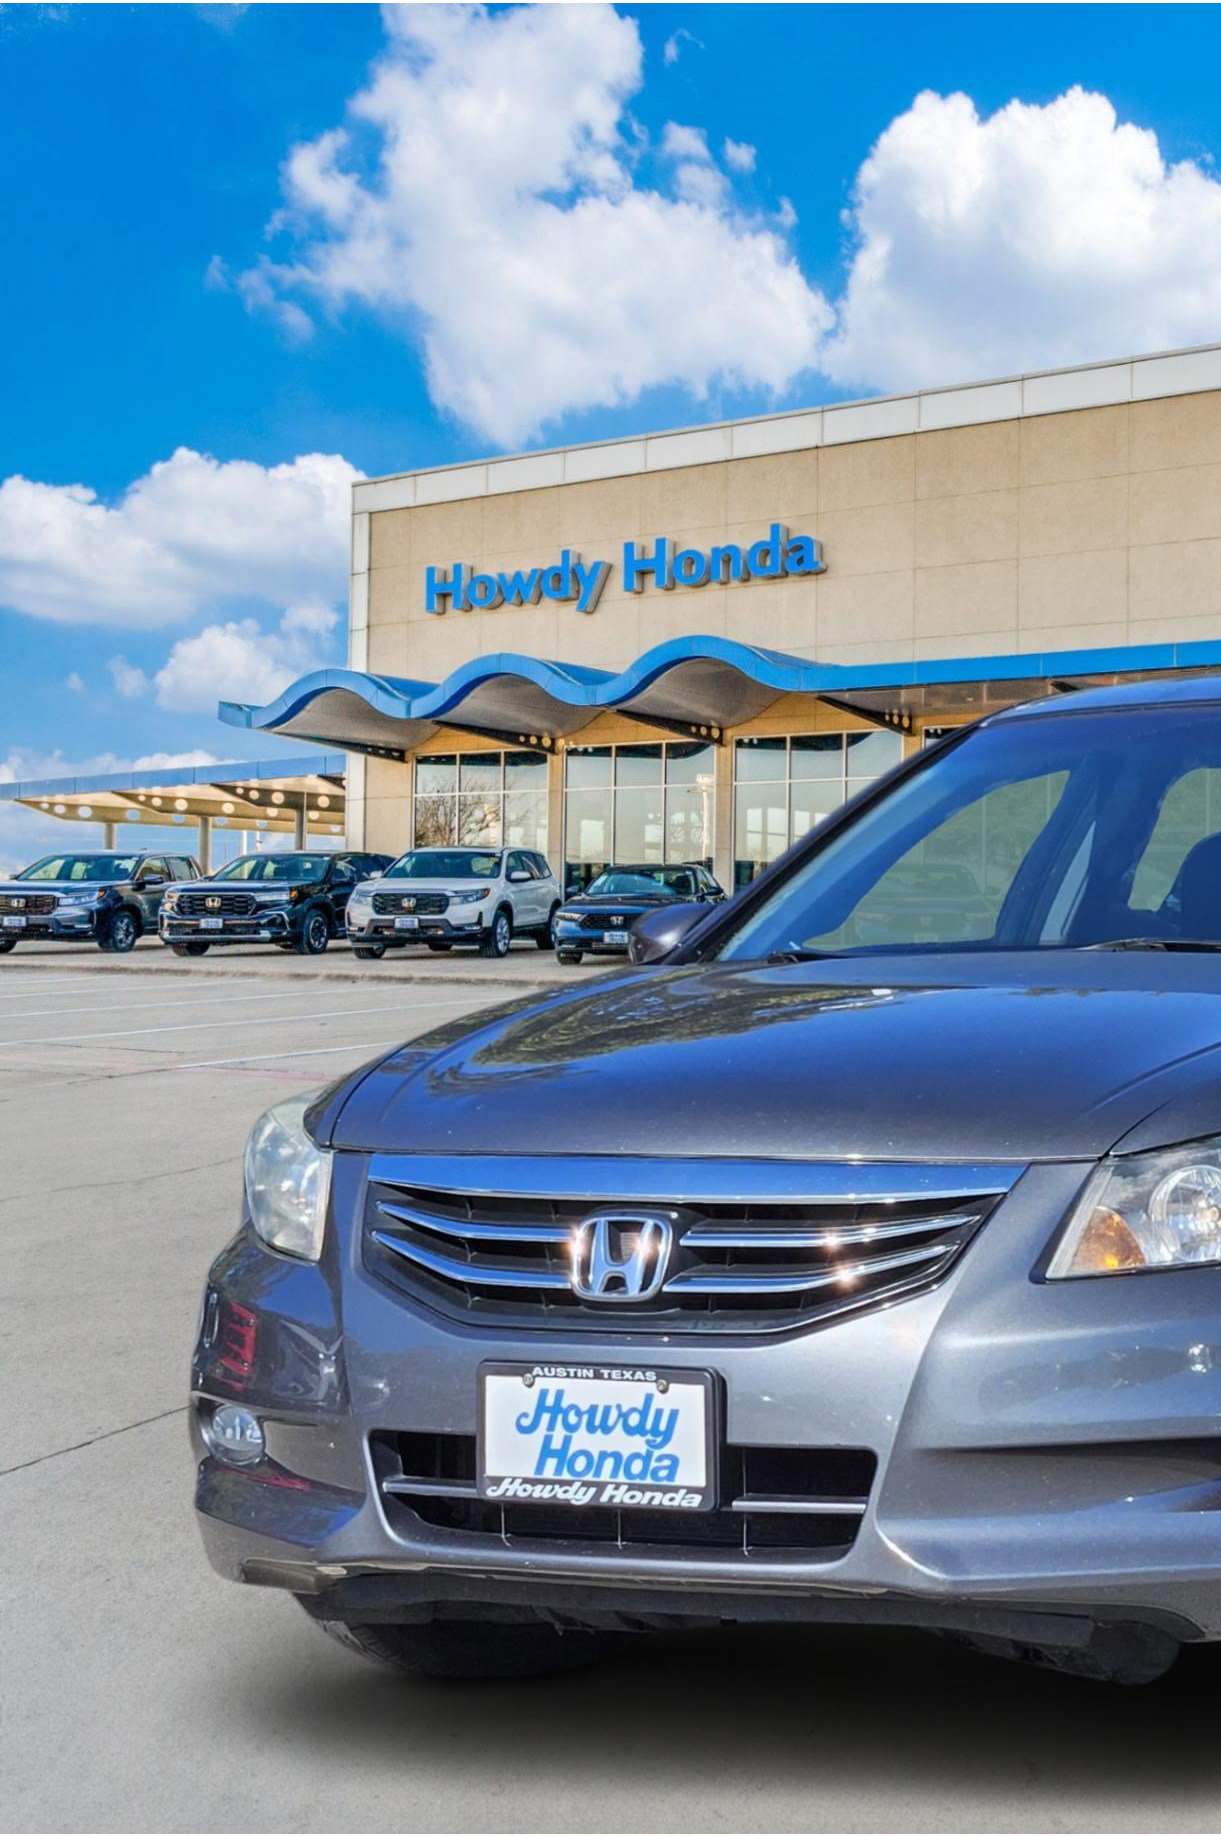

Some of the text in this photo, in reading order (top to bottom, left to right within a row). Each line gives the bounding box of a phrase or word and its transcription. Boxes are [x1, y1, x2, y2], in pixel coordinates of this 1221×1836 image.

[425, 523, 827, 614] Howdy Honda
[532, 1366, 657, 1381] AUSTIN TEXAS
[515, 1388, 680, 1450] Howdy
[534, 1434, 680, 1482] Honda
[486, 1478, 703, 1508] Howdy Honda
